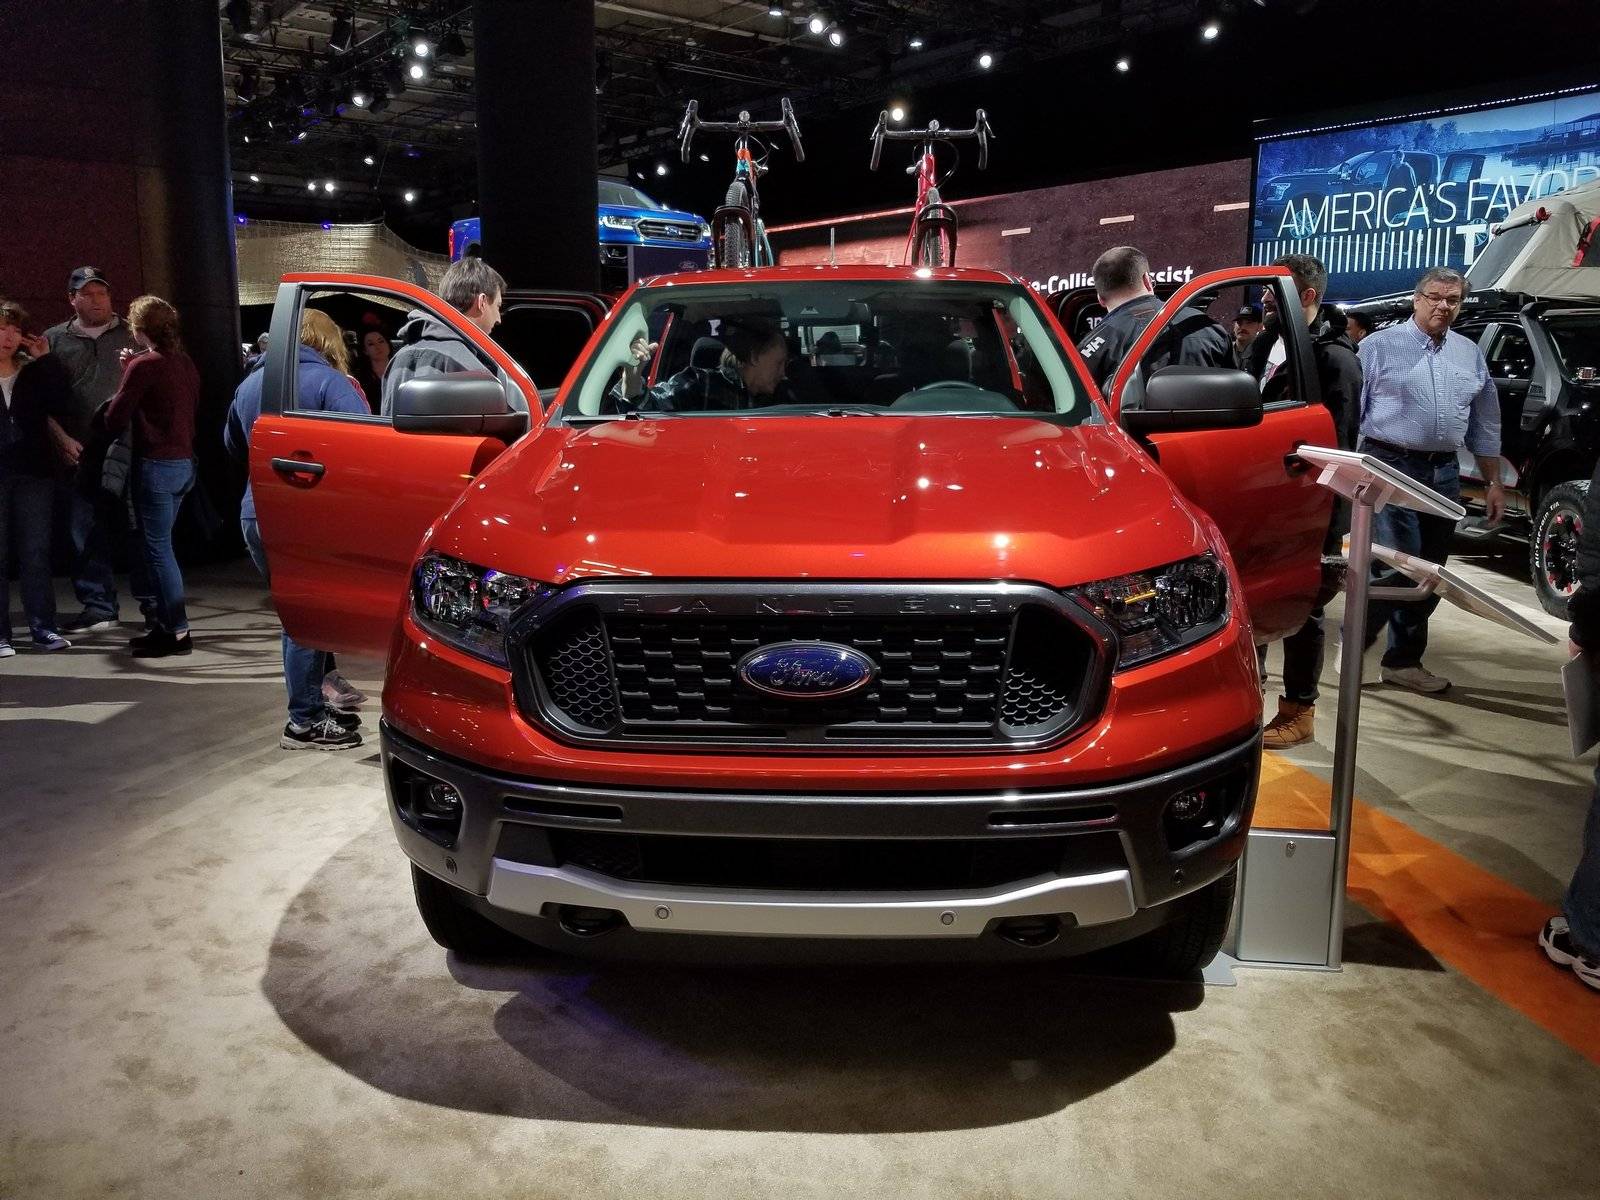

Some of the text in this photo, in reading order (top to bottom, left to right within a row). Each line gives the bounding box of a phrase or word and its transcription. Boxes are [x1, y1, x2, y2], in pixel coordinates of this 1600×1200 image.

[1276, 181, 1458, 238] AMERICA'S
[618, 598, 998, 614] RANGER
[769, 657, 840, 686] Ford
